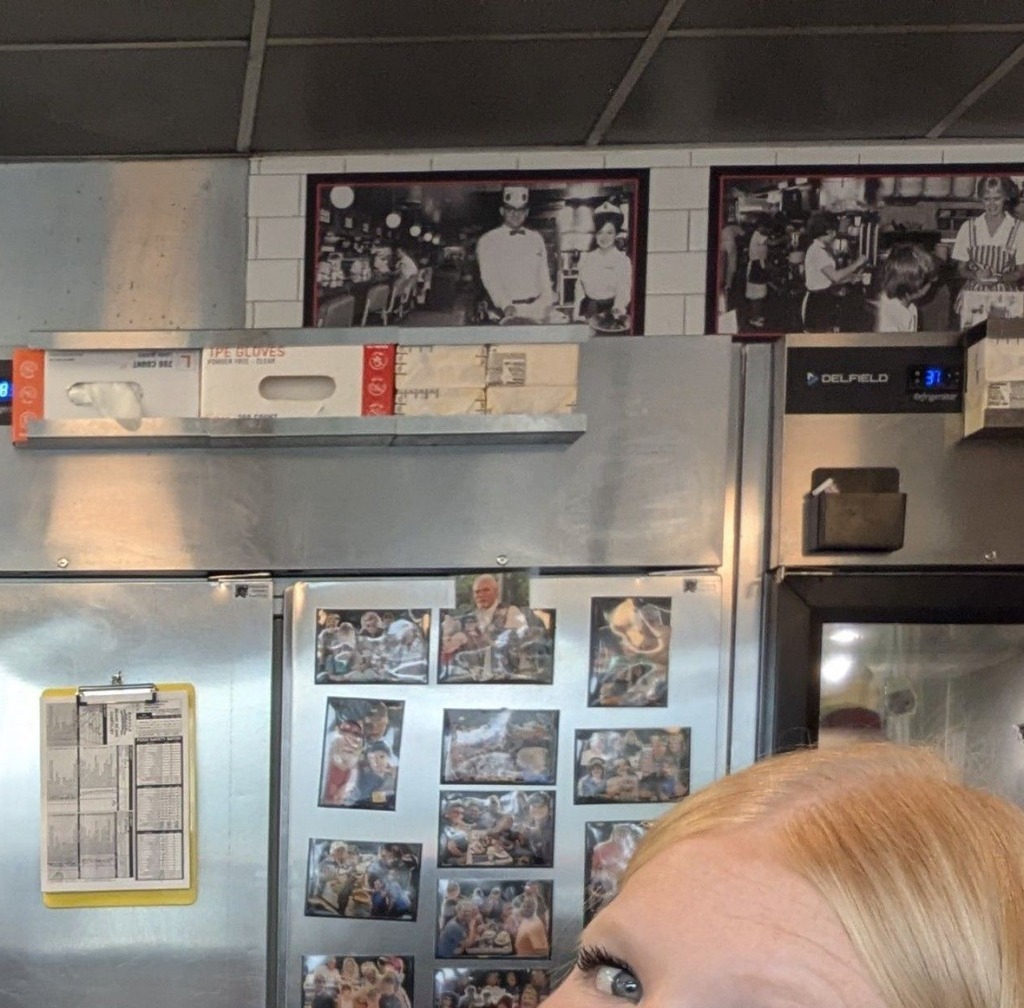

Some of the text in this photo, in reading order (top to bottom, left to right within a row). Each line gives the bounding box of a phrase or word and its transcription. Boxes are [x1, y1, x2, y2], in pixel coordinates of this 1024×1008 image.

[236, 344, 286, 357] GLOVES
[820, 373, 889, 384] DELFIELD
[925, 370, 941, 385] 37
